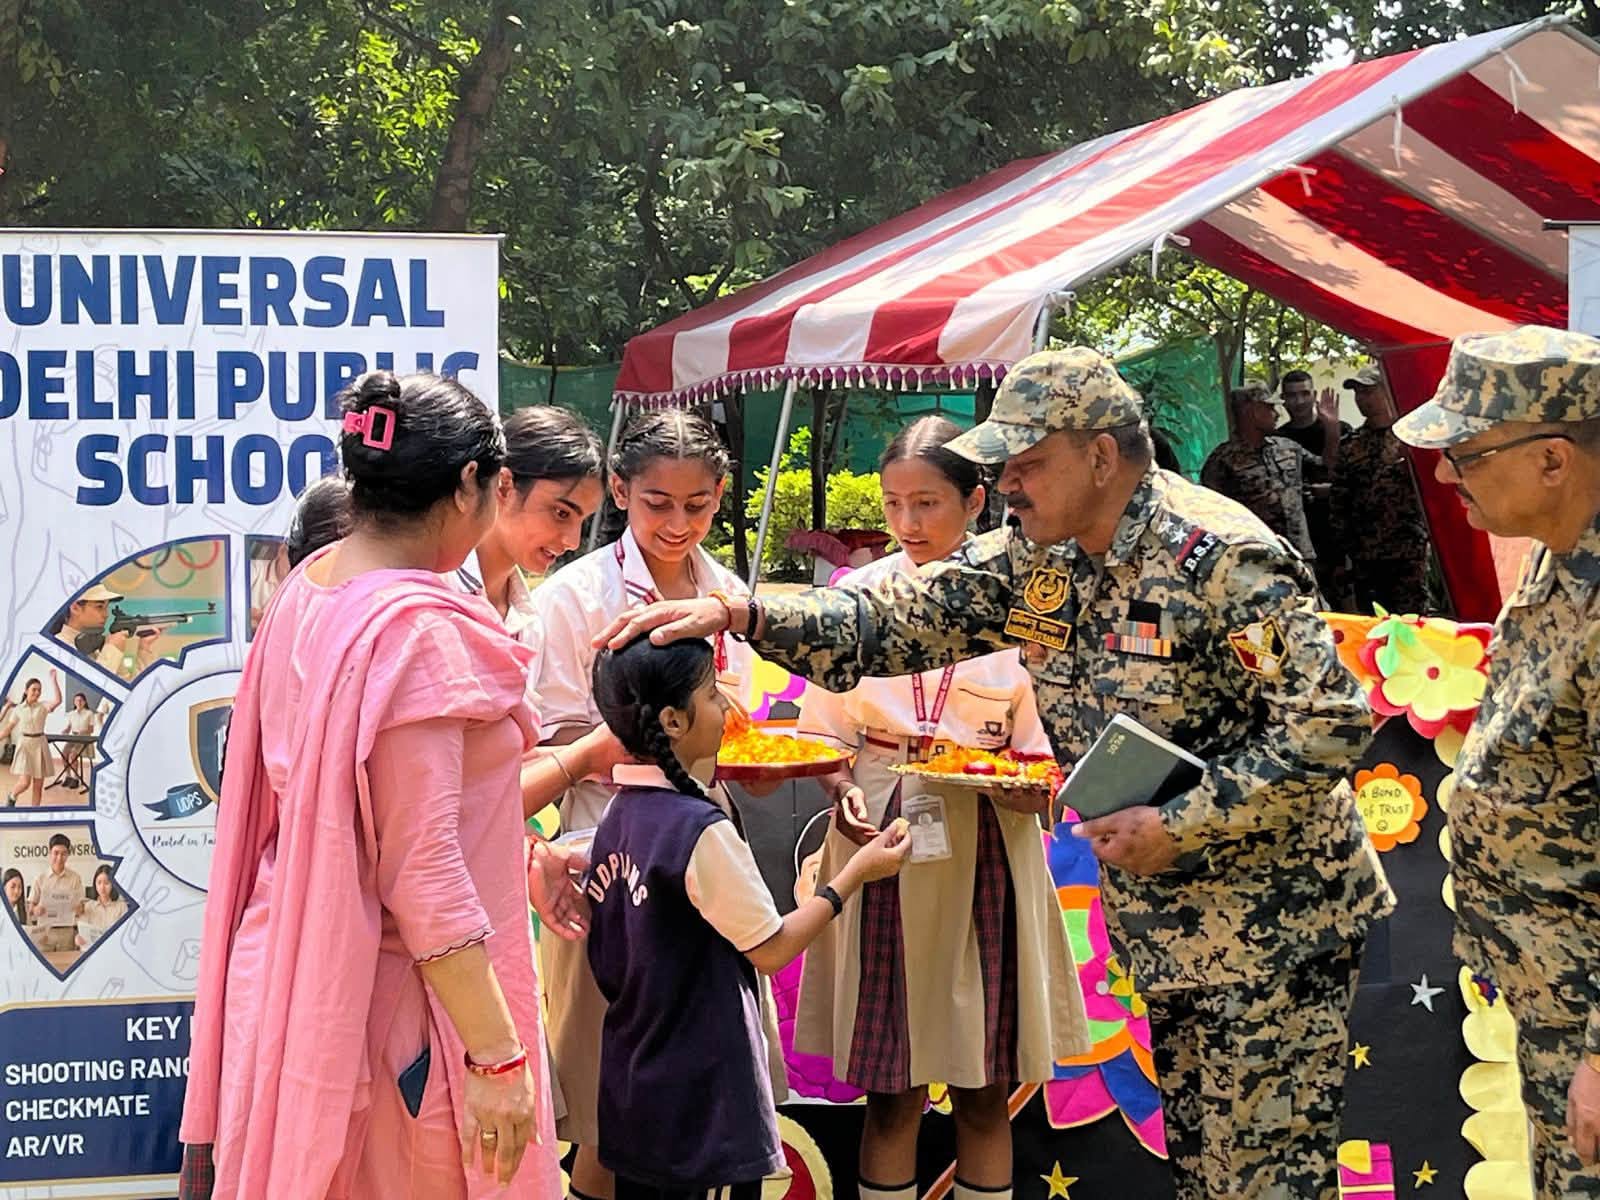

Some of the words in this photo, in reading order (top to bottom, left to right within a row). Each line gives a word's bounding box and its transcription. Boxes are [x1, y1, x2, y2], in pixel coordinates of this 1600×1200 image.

[3, 254, 445, 328] UNIVERSAL
[217, 350, 479, 421] PUB
[76, 433, 338, 506] SCHOO
[176, 791, 203, 813] UDPS
[1360, 789, 1366, 799] A
[1371, 786, 1402, 798] BOND
[1379, 803, 1410, 816] TRUST
[14, 845, 48, 858] SCHOO
[126, 1016, 182, 1042] KEY
[5, 1059, 124, 1085] SHOOTING
[6, 1095, 150, 1121] CHECKMATE
[6, 1134, 84, 1158] AR/VR
